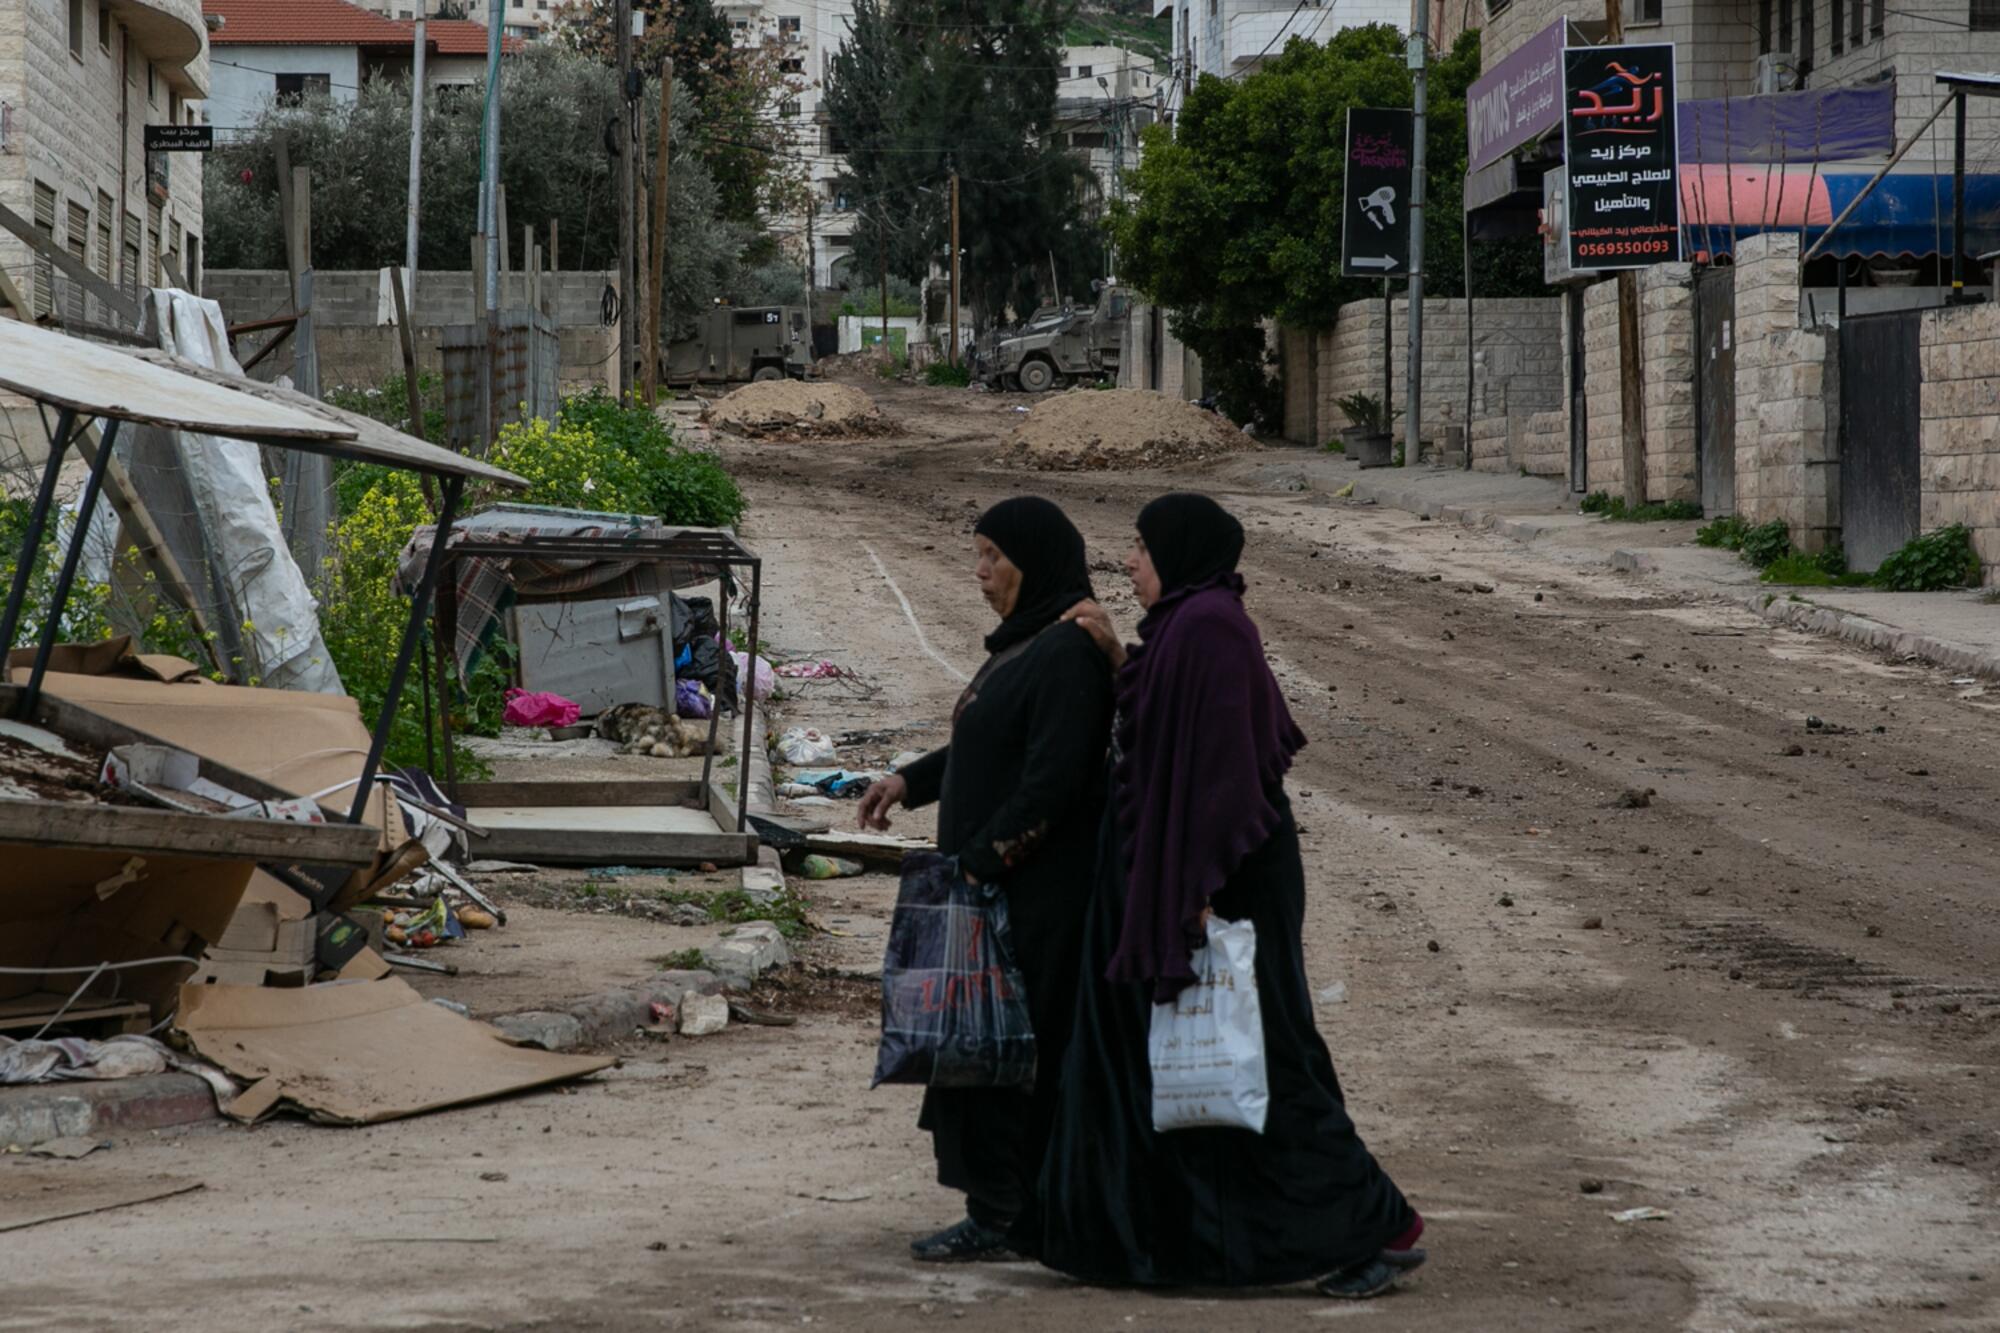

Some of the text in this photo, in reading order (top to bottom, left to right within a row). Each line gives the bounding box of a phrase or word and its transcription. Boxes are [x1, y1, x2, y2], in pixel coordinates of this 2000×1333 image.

[1571, 72, 1664, 123] زيد
[1590, 144, 1651, 160] مركز زيد
[1572, 168, 1671, 187] للعلاج الطبيعي
[1594, 193, 1650, 212] والتأهيل
[1614, 226, 1629, 237] زيد
[1578, 240, 1669, 256] 0569550093
